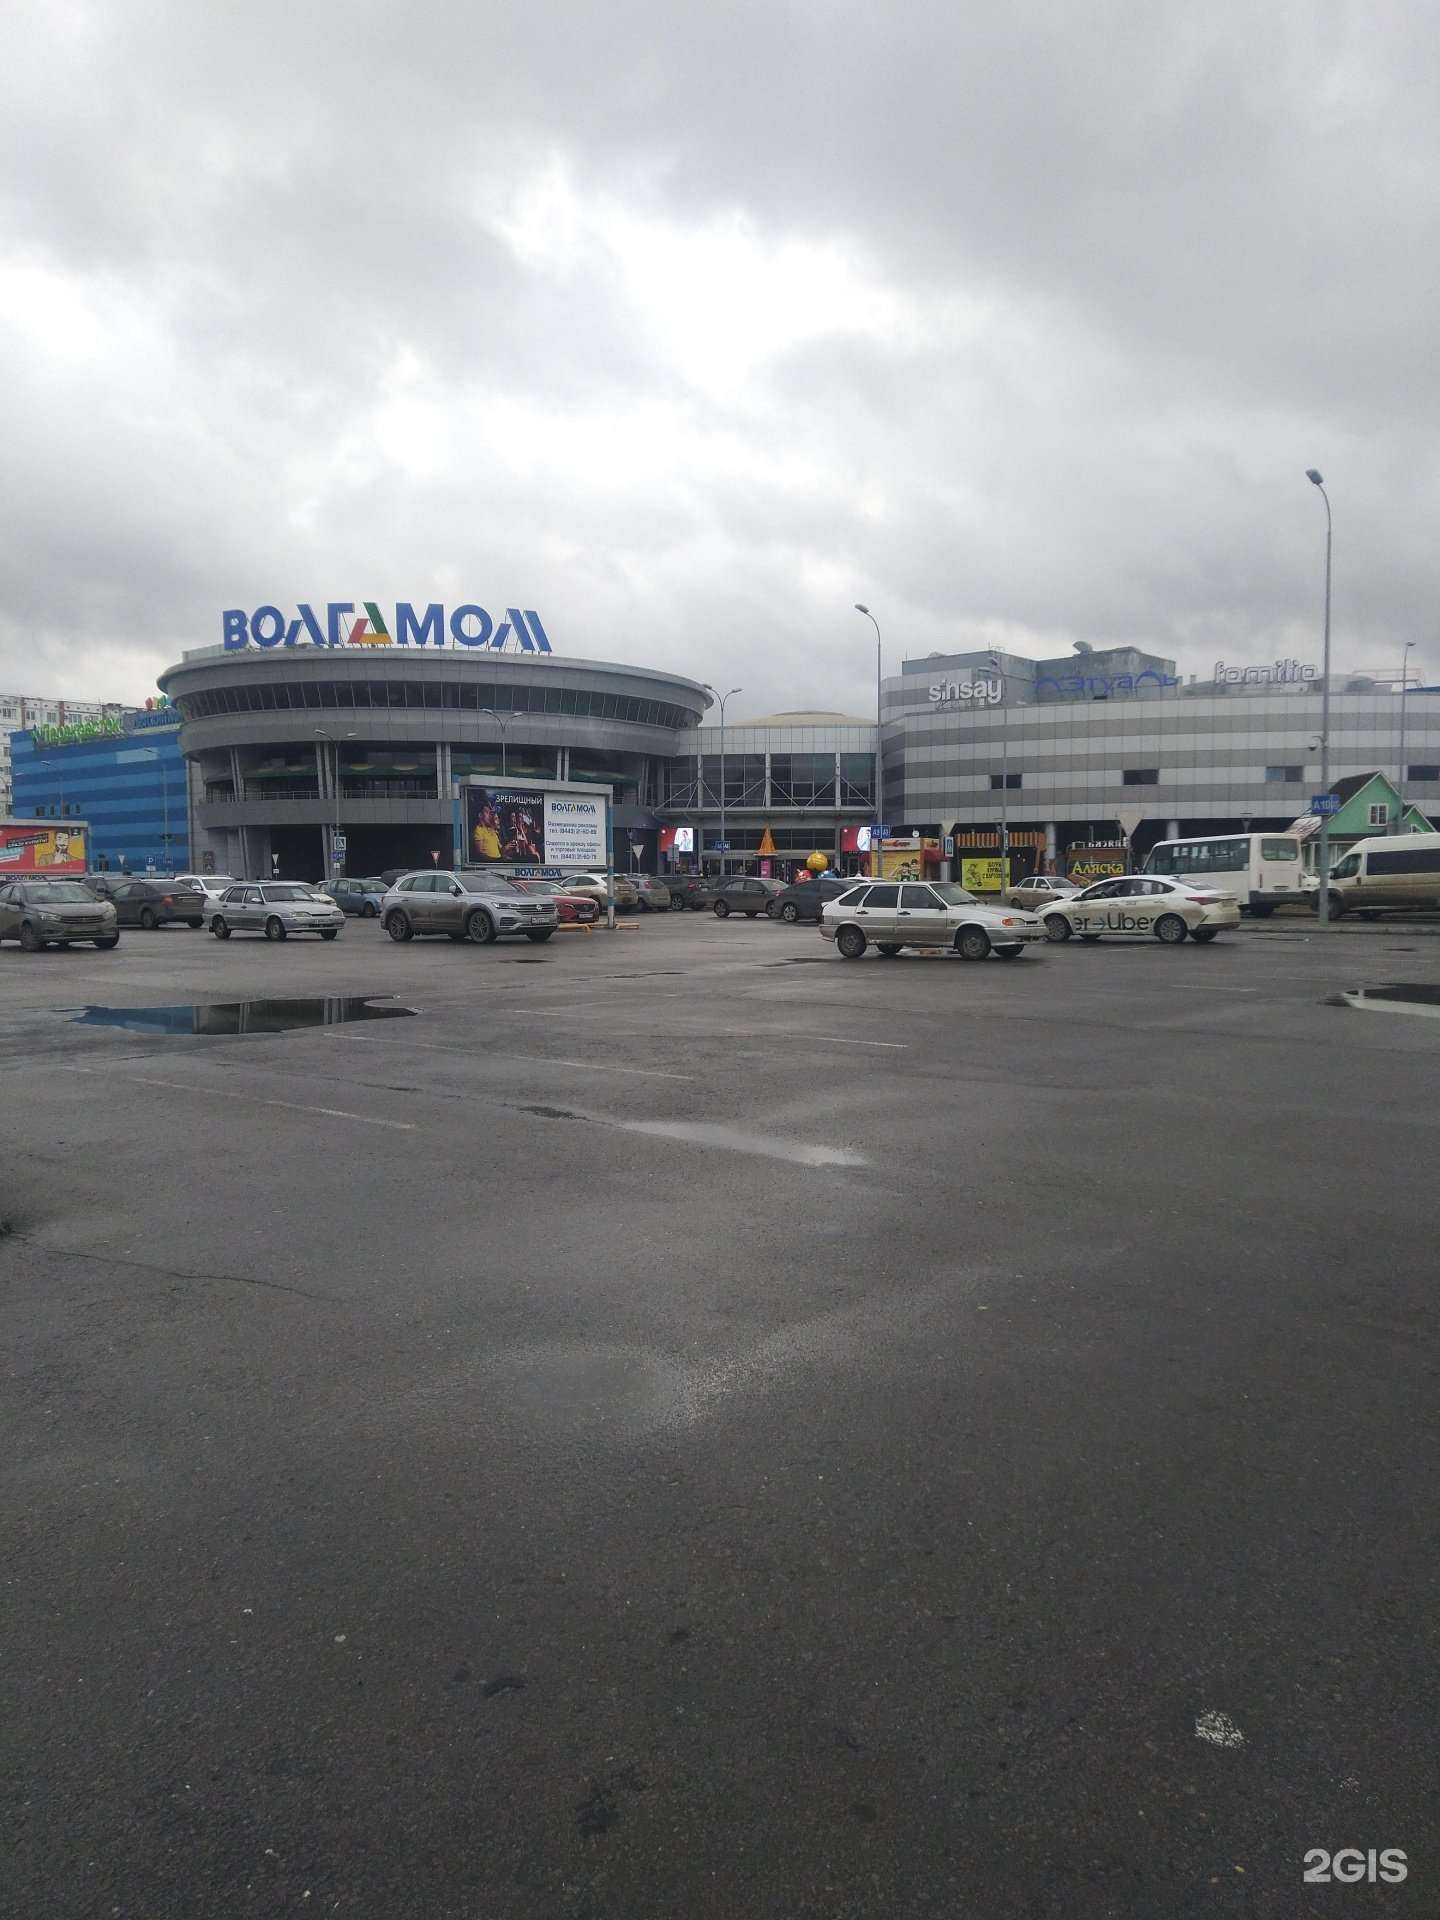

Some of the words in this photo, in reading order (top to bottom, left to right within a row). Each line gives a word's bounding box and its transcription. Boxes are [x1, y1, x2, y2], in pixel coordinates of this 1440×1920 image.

[928, 680, 1001, 704] sinsay
[495, 794, 542, 805] ЗРЕЛИЩНЫЙ
[1107, 912, 1155, 931] Uber
